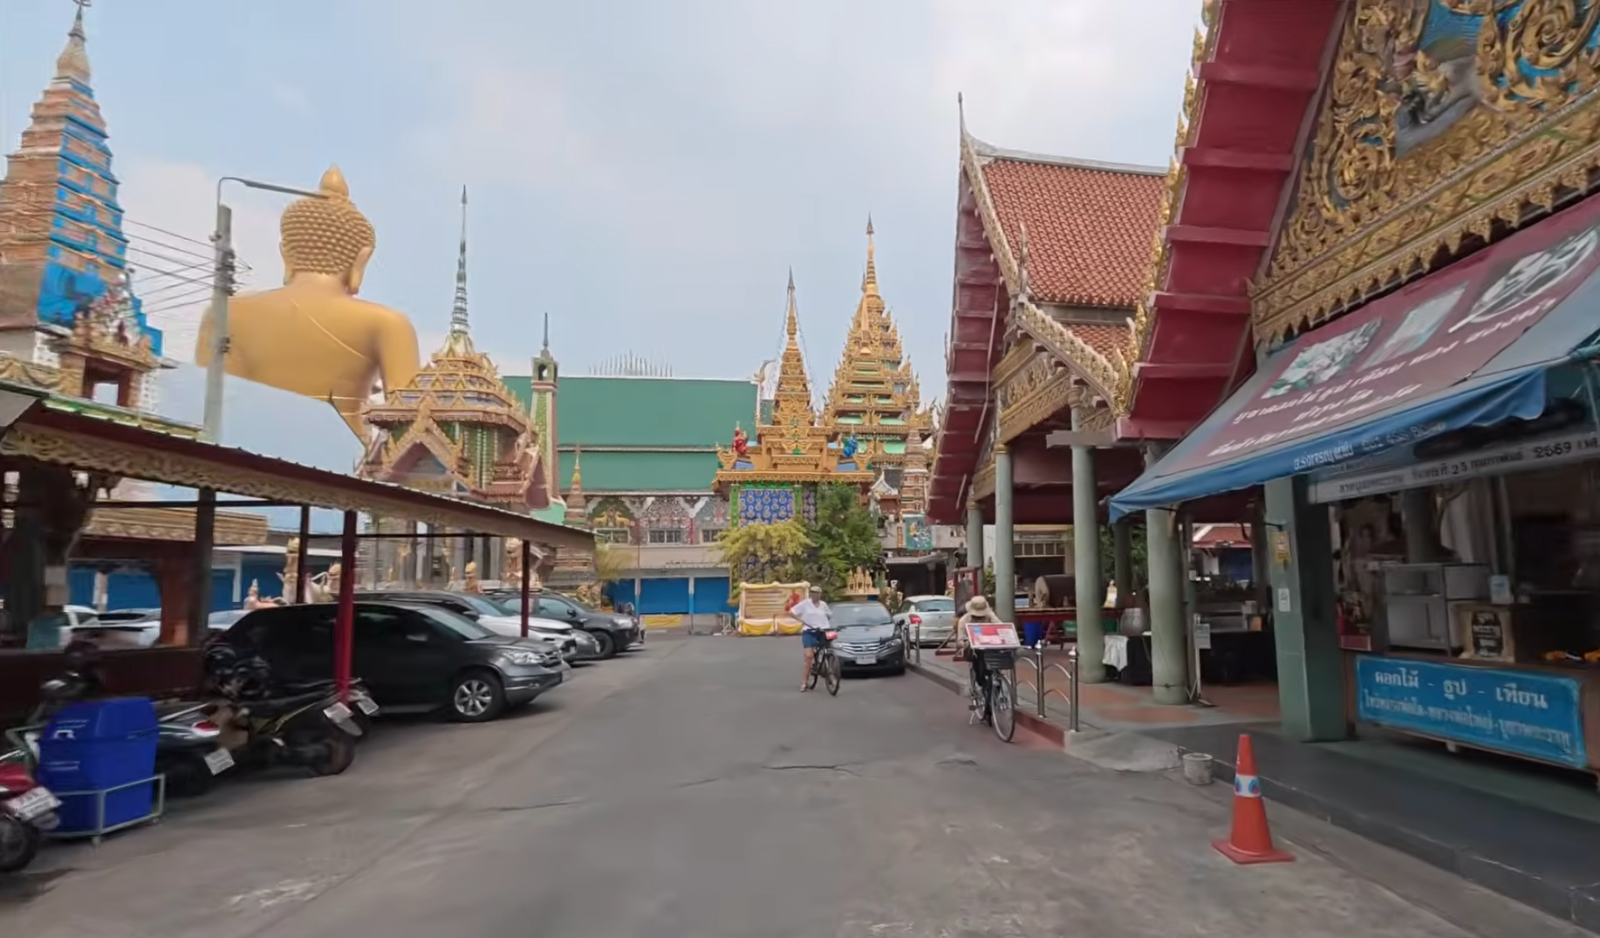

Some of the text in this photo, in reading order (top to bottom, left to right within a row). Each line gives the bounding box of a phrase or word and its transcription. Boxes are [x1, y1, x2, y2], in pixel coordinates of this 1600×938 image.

[1375, 667, 1550, 710] ดอกไม้ ธูป เทียน
